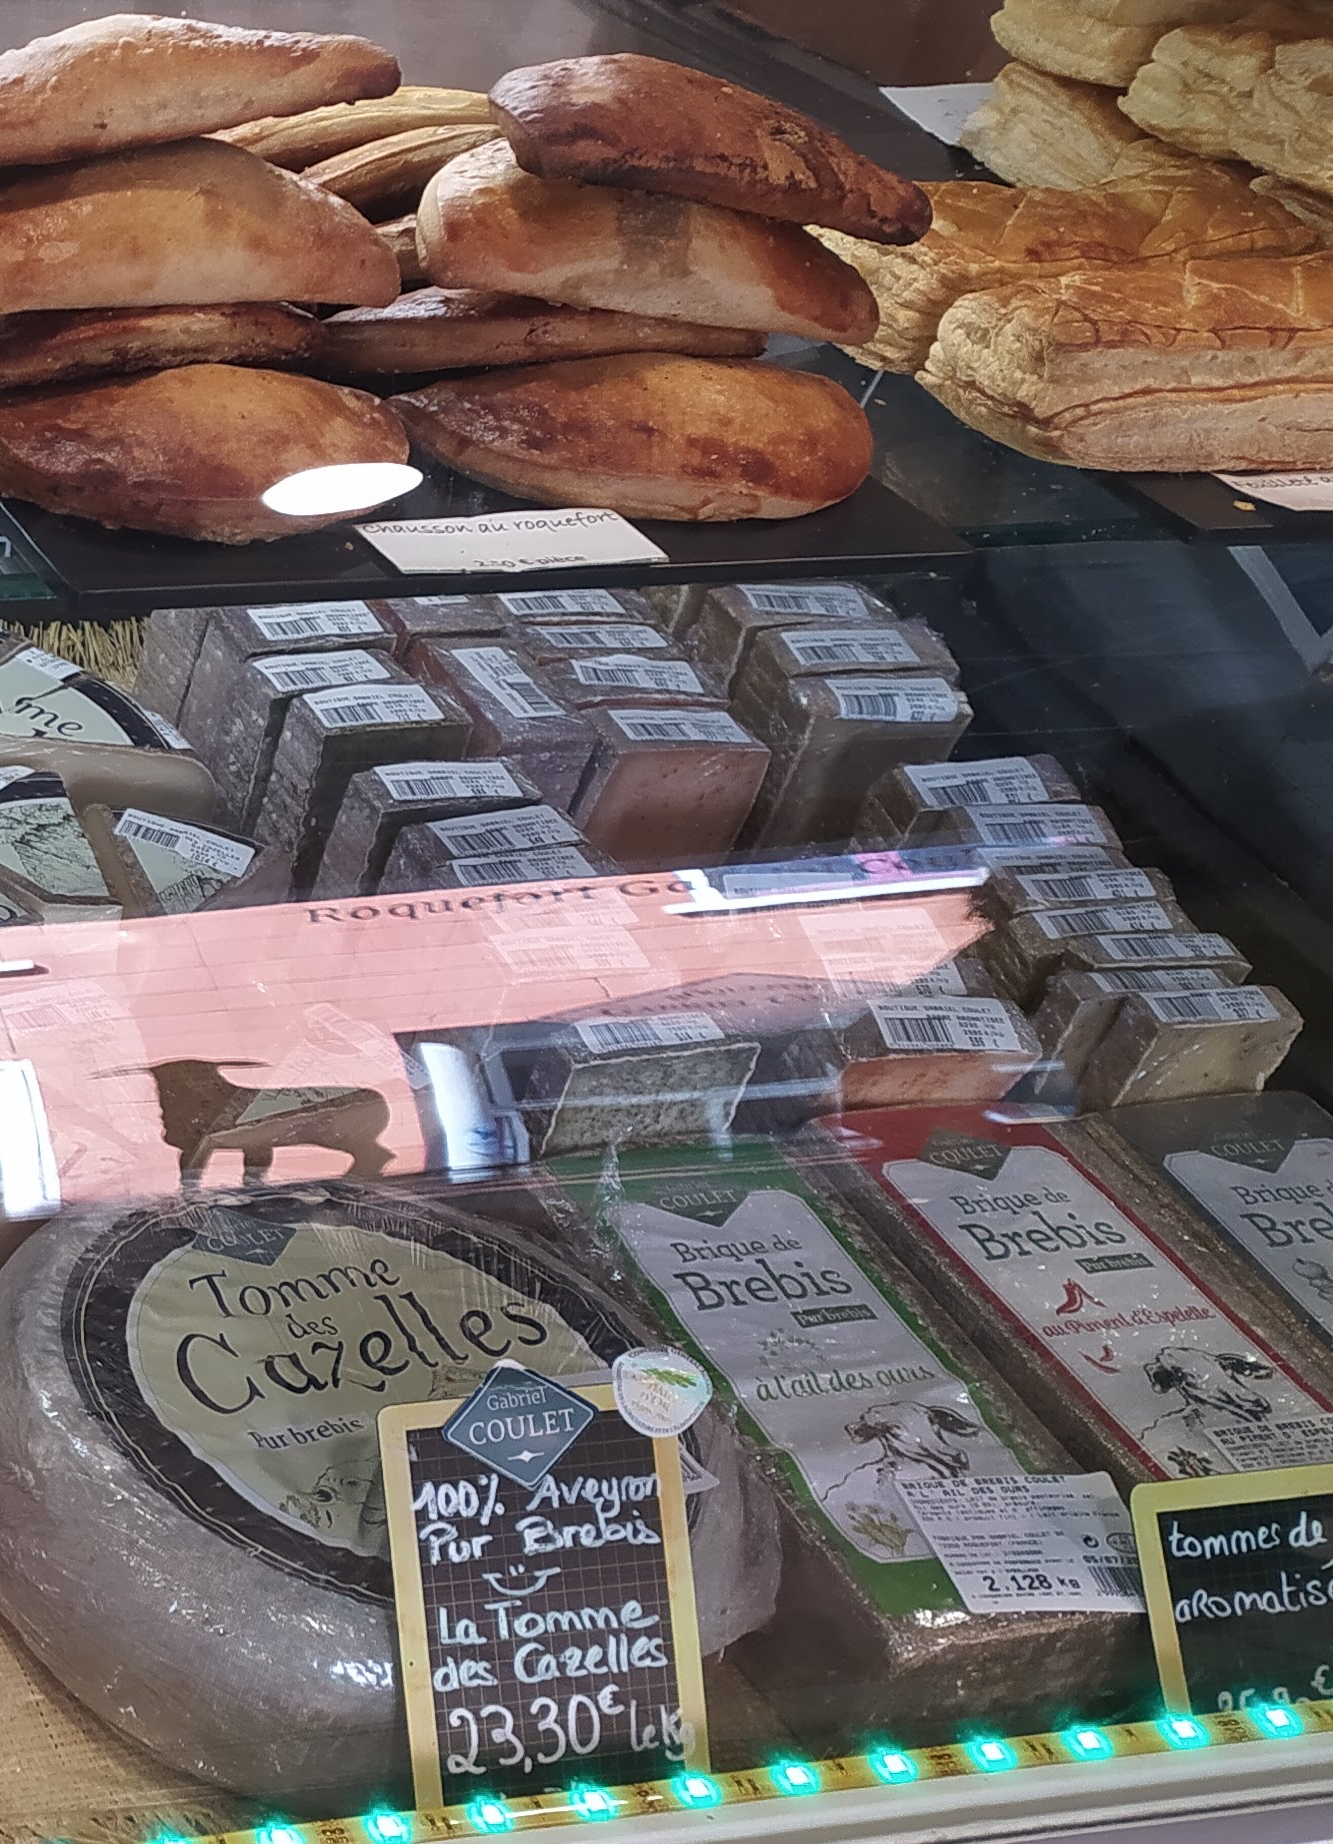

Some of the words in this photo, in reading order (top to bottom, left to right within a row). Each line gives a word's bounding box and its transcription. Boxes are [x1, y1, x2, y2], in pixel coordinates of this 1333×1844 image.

[479, 519, 507, 535] au
[513, 511, 619, 534] roquefort
[949, 1191, 1039, 1217] Brique
[1043, 1186, 1072, 1204] de
[1231, 1181, 1321, 1207] Brique
[670, 1236, 766, 1265] Brique
[771, 1233, 804, 1252] de
[958, 1210, 1128, 1262] Brebis
[188, 1255, 402, 1319] Tomme
[672, 1259, 853, 1312] Brebis
[285, 1312, 339, 1339] des
[176, 1290, 549, 1414] Cazelles
[486, 1387, 547, 1411] Gabriel
[831, 1367, 874, 1393] des
[248, 1429, 292, 1450] Pur
[291, 1416, 365, 1446] brebis
[469, 1406, 577, 1446] COULET
[410, 1473, 506, 1526] 100%
[526, 1472, 663, 1519] Aveyron
[419, 1521, 494, 1566] Pur
[516, 1508, 663, 1557] Brebis
[1168, 1520, 1281, 1560] tommes
[1287, 1511, 1328, 1548] de
[982, 1573, 1053, 1592] 2.128
[439, 1606, 488, 1646] La
[484, 1599, 660, 1640] Tomme
[434, 1659, 499, 1692] des
[513, 1633, 669, 1685] Cazelles
